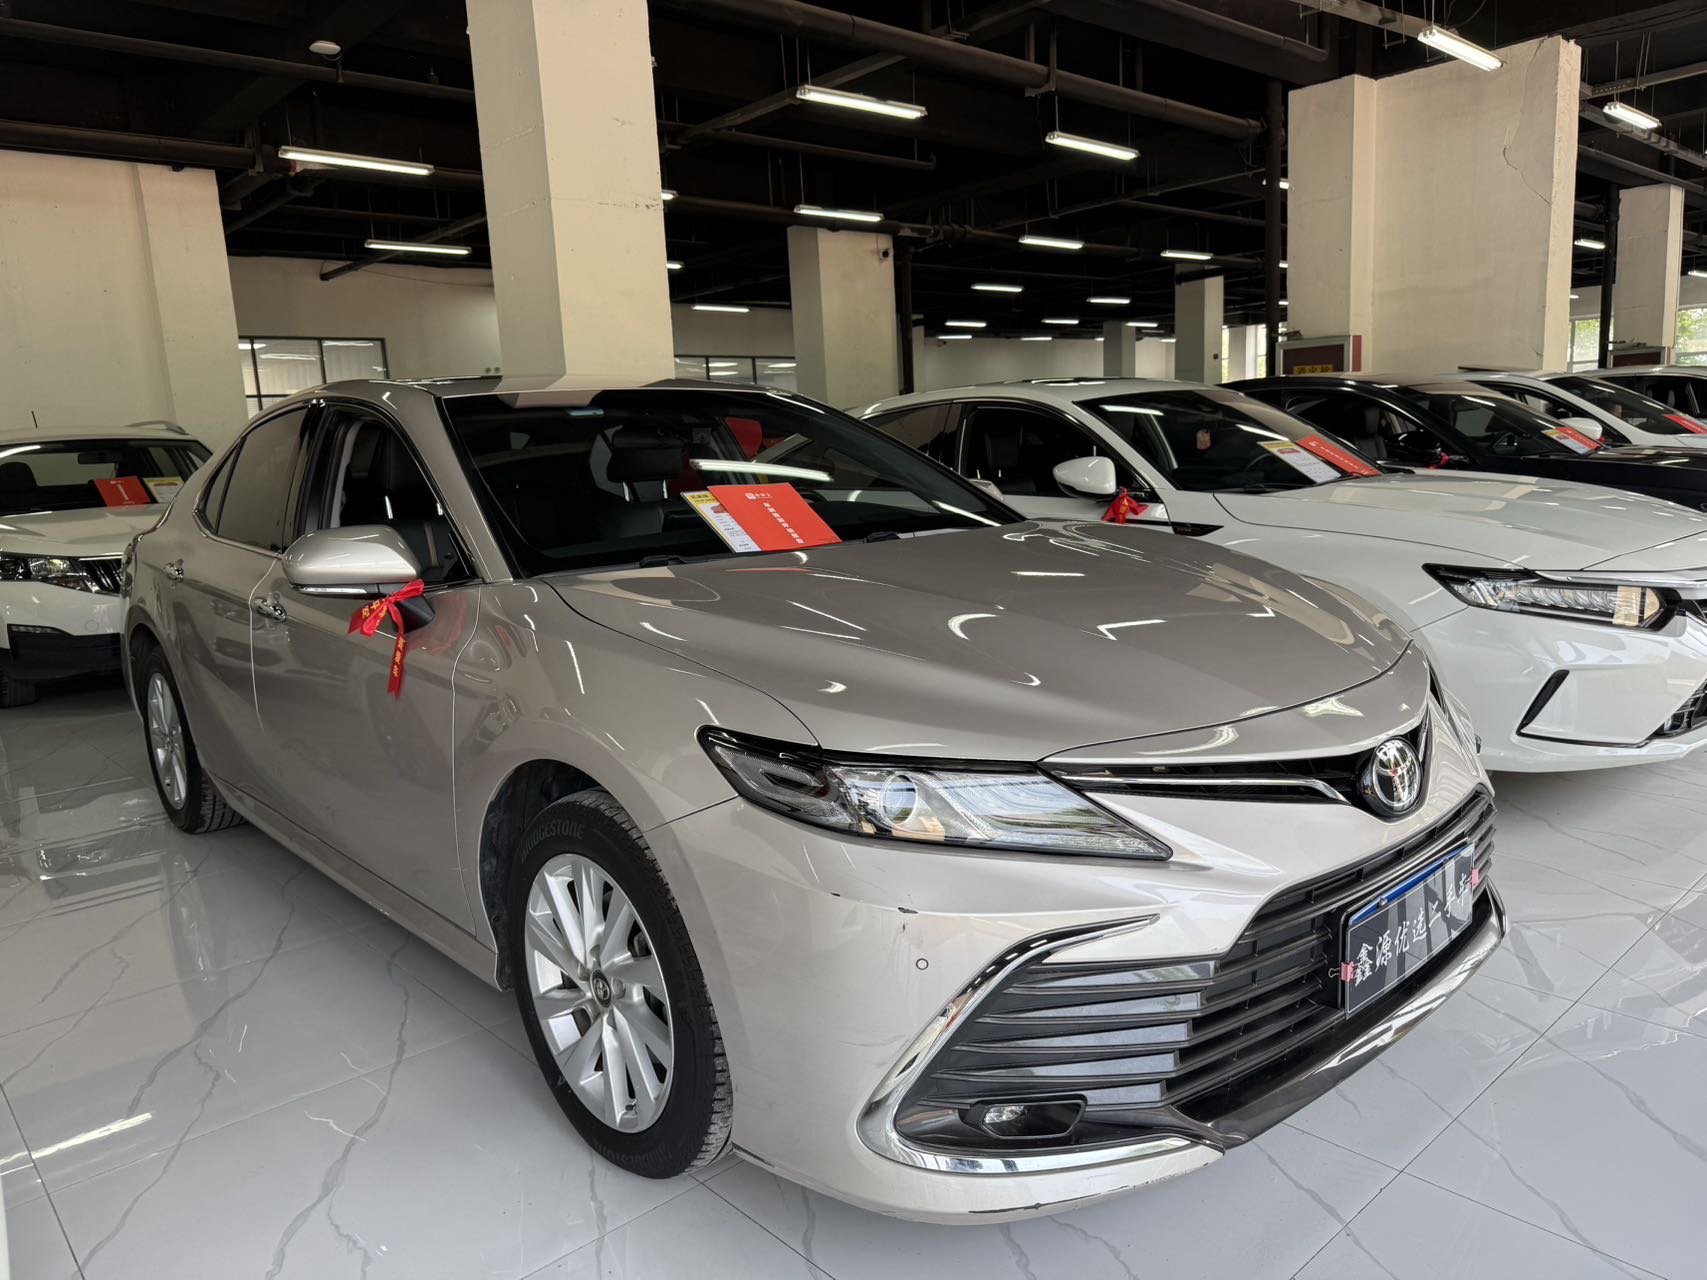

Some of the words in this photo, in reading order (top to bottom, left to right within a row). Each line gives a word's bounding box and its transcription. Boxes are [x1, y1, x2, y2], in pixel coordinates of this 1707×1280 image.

[1354, 873, 1470, 986] 鑫源优选二手车
